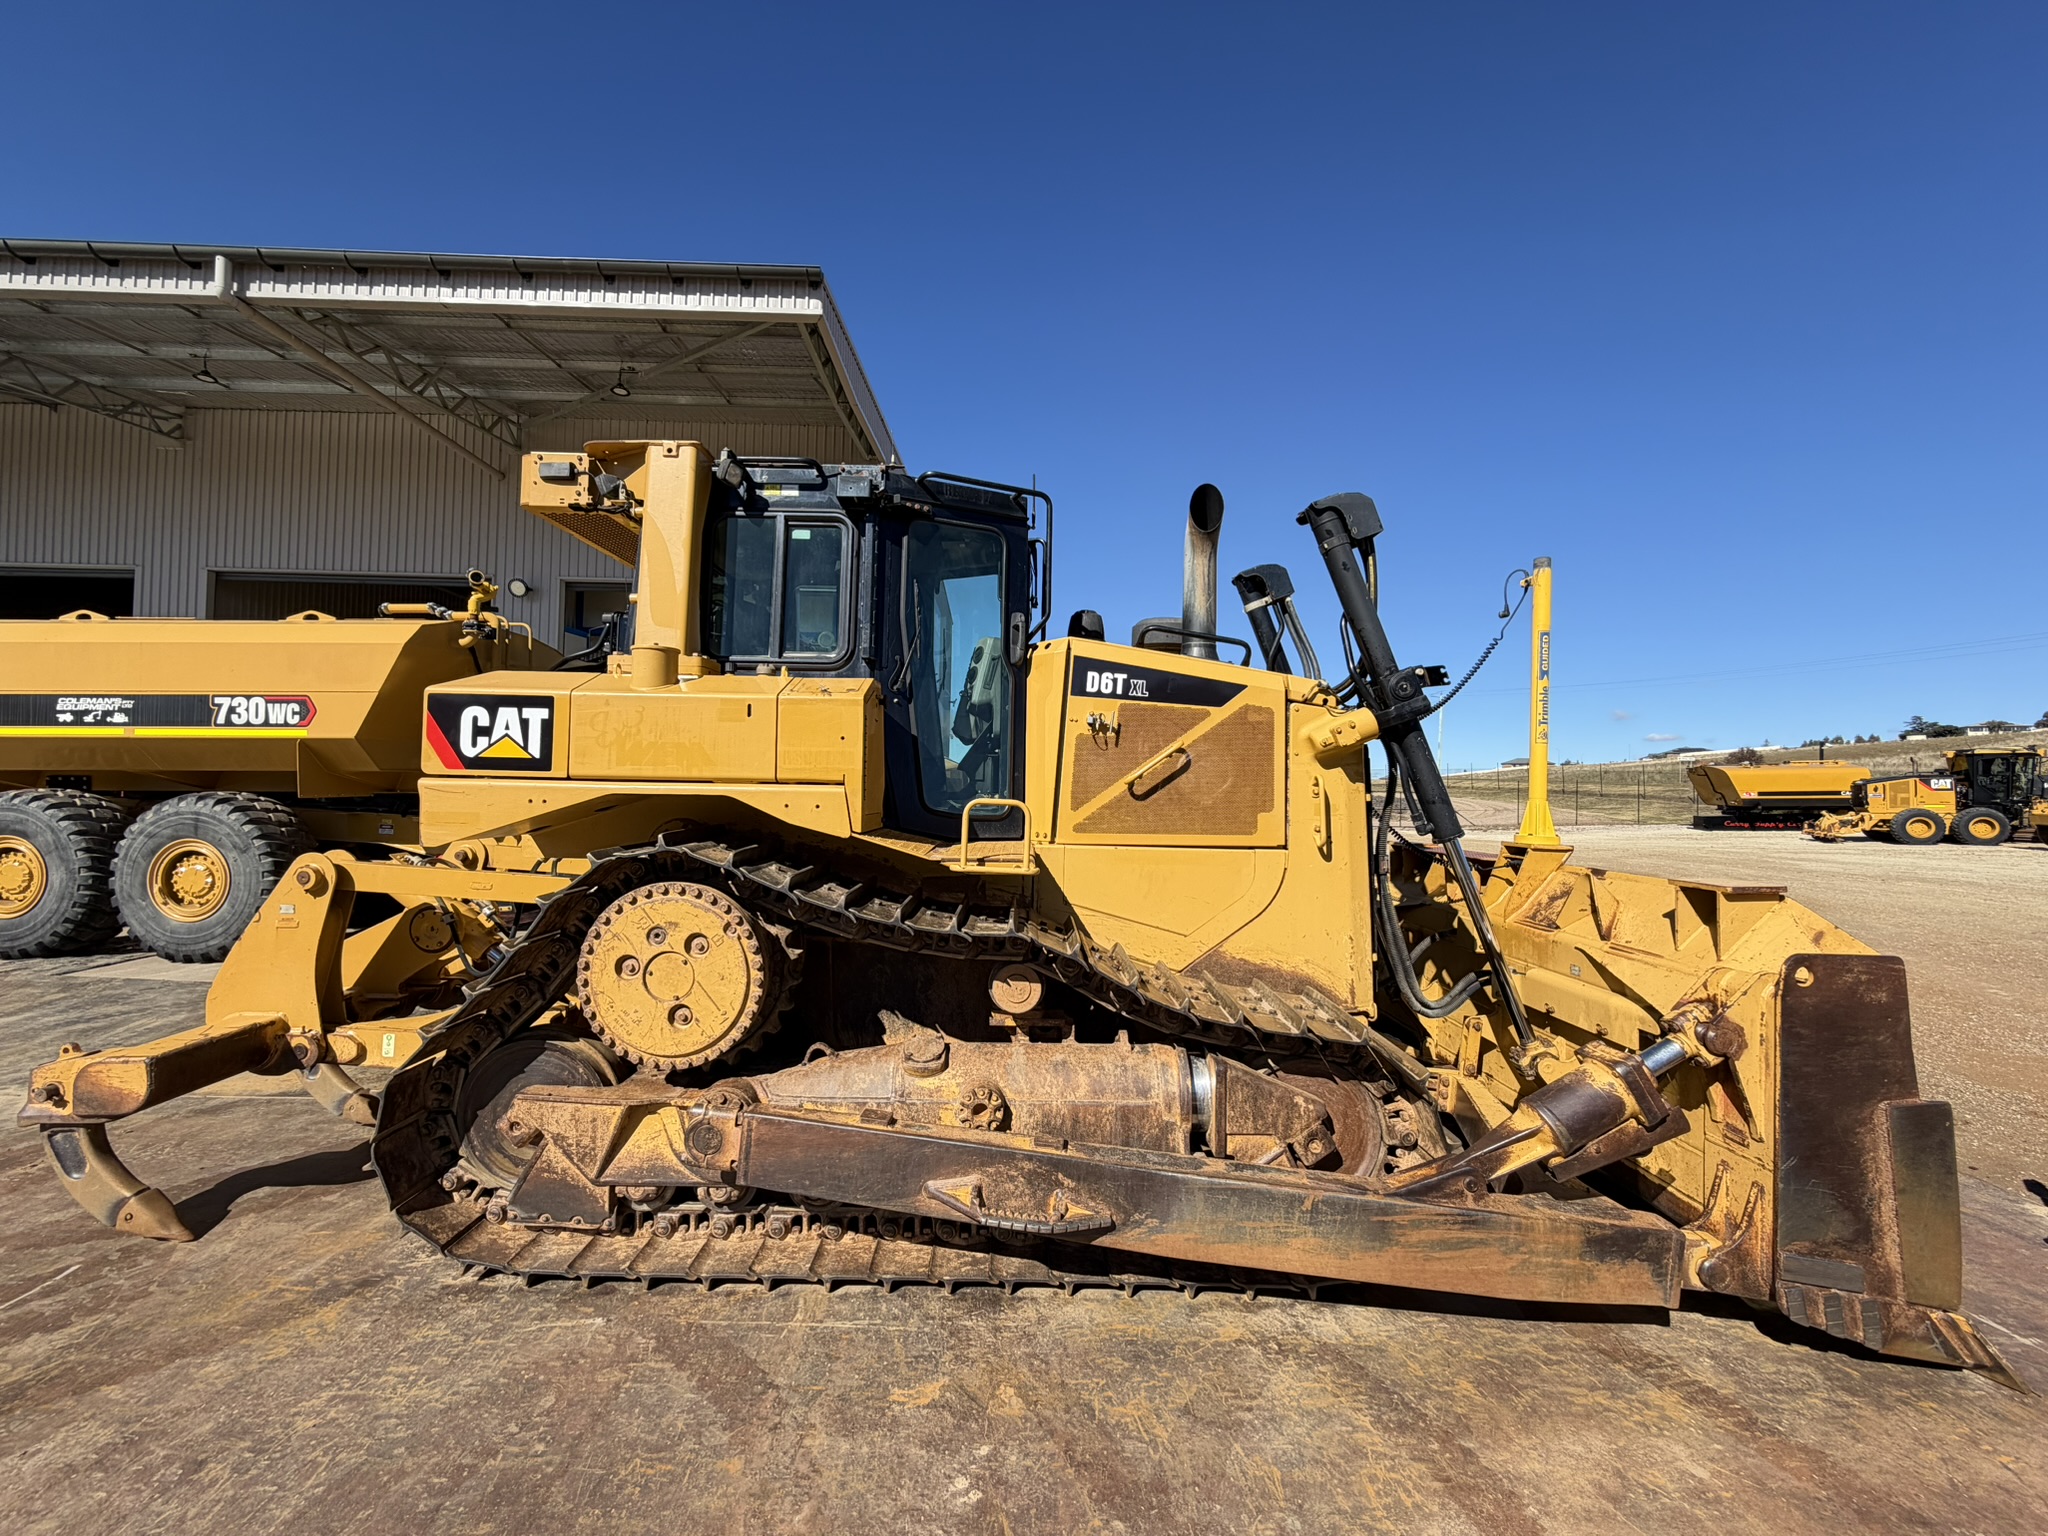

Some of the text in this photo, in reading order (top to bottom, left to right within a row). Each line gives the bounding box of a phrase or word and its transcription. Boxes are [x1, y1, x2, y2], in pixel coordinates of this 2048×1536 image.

[1541, 635, 1549, 671] GUIDED
[1085, 671, 1149, 697] D6T XL
[56, 703, 120, 711] EQUIPMENT
[1538, 686, 1549, 727] Trimble
[459, 705, 549, 759] CAT
[1930, 778, 1952, 789] CAT
